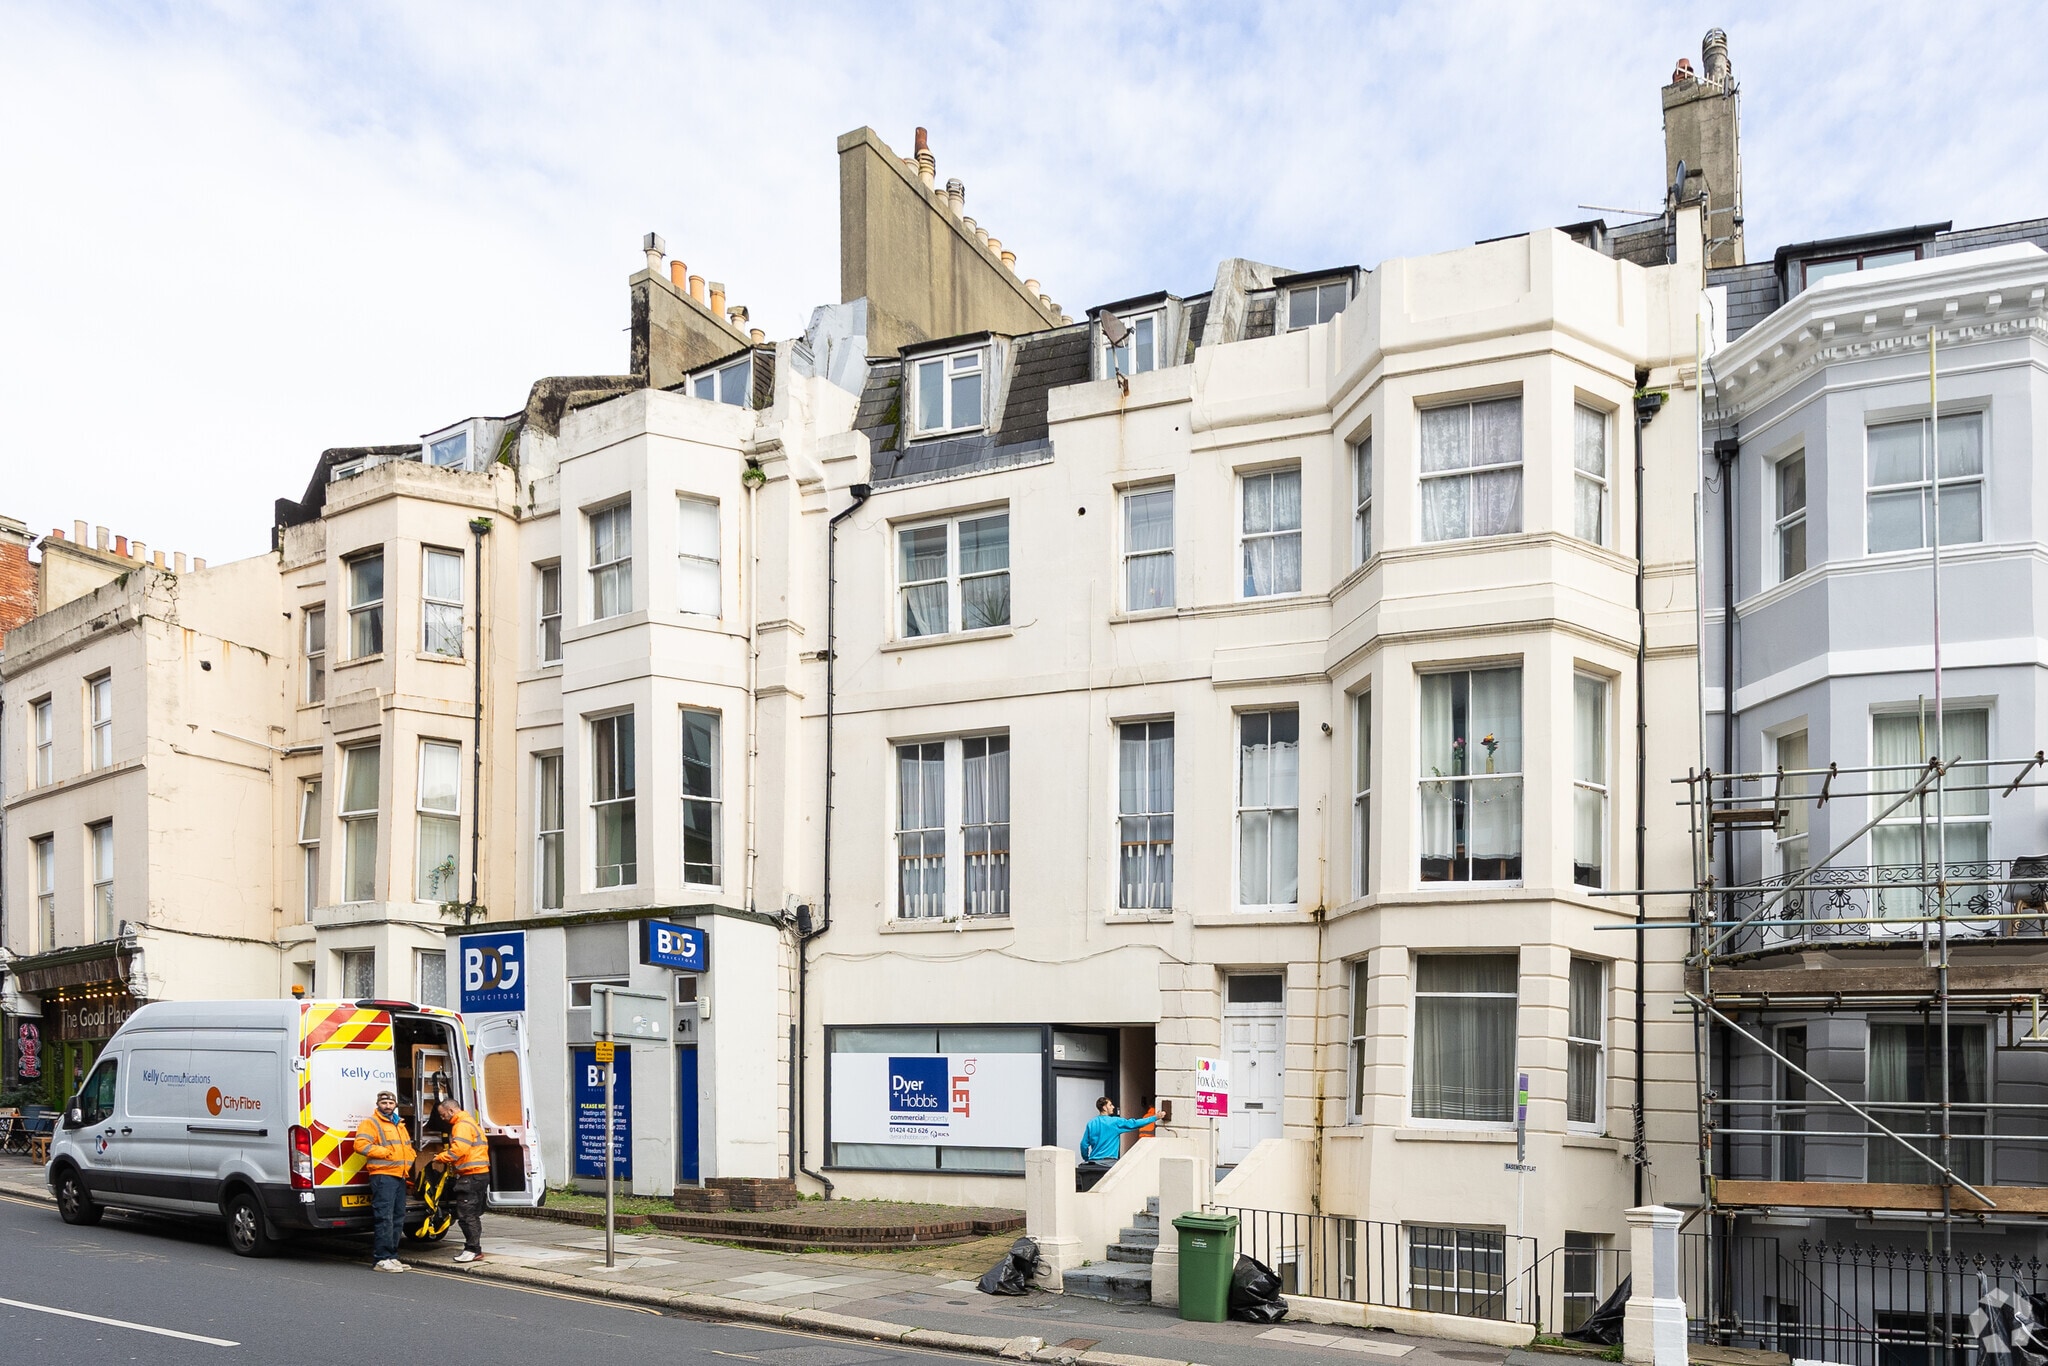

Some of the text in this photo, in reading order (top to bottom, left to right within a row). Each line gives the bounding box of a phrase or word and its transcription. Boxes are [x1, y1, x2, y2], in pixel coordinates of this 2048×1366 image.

[657, 928, 697, 958] BDG
[658, 954, 697, 964] SOLICITORS
[465, 945, 520, 992] BDG
[465, 993, 520, 1002] SOLICITORS
[61, 1004, 132, 1028] The Good Place
[677, 1019, 692, 1033] 51
[341, 1067, 370, 1080] Kelly
[964, 1057, 977, 1075] to
[143, 1069, 211, 1085] Kelly Communications
[892, 1075, 924, 1094] Dyer
[1198, 1072, 1229, 1090] fox & sons
[223, 1095, 261, 1111] CityFibre
[900, 1093, 938, 1108] Hobbis
[952, 1076, 970, 1118] LET
[1197, 1092, 1217, 1104] for sale
[1526, 1164, 1537, 1172] FLAT
